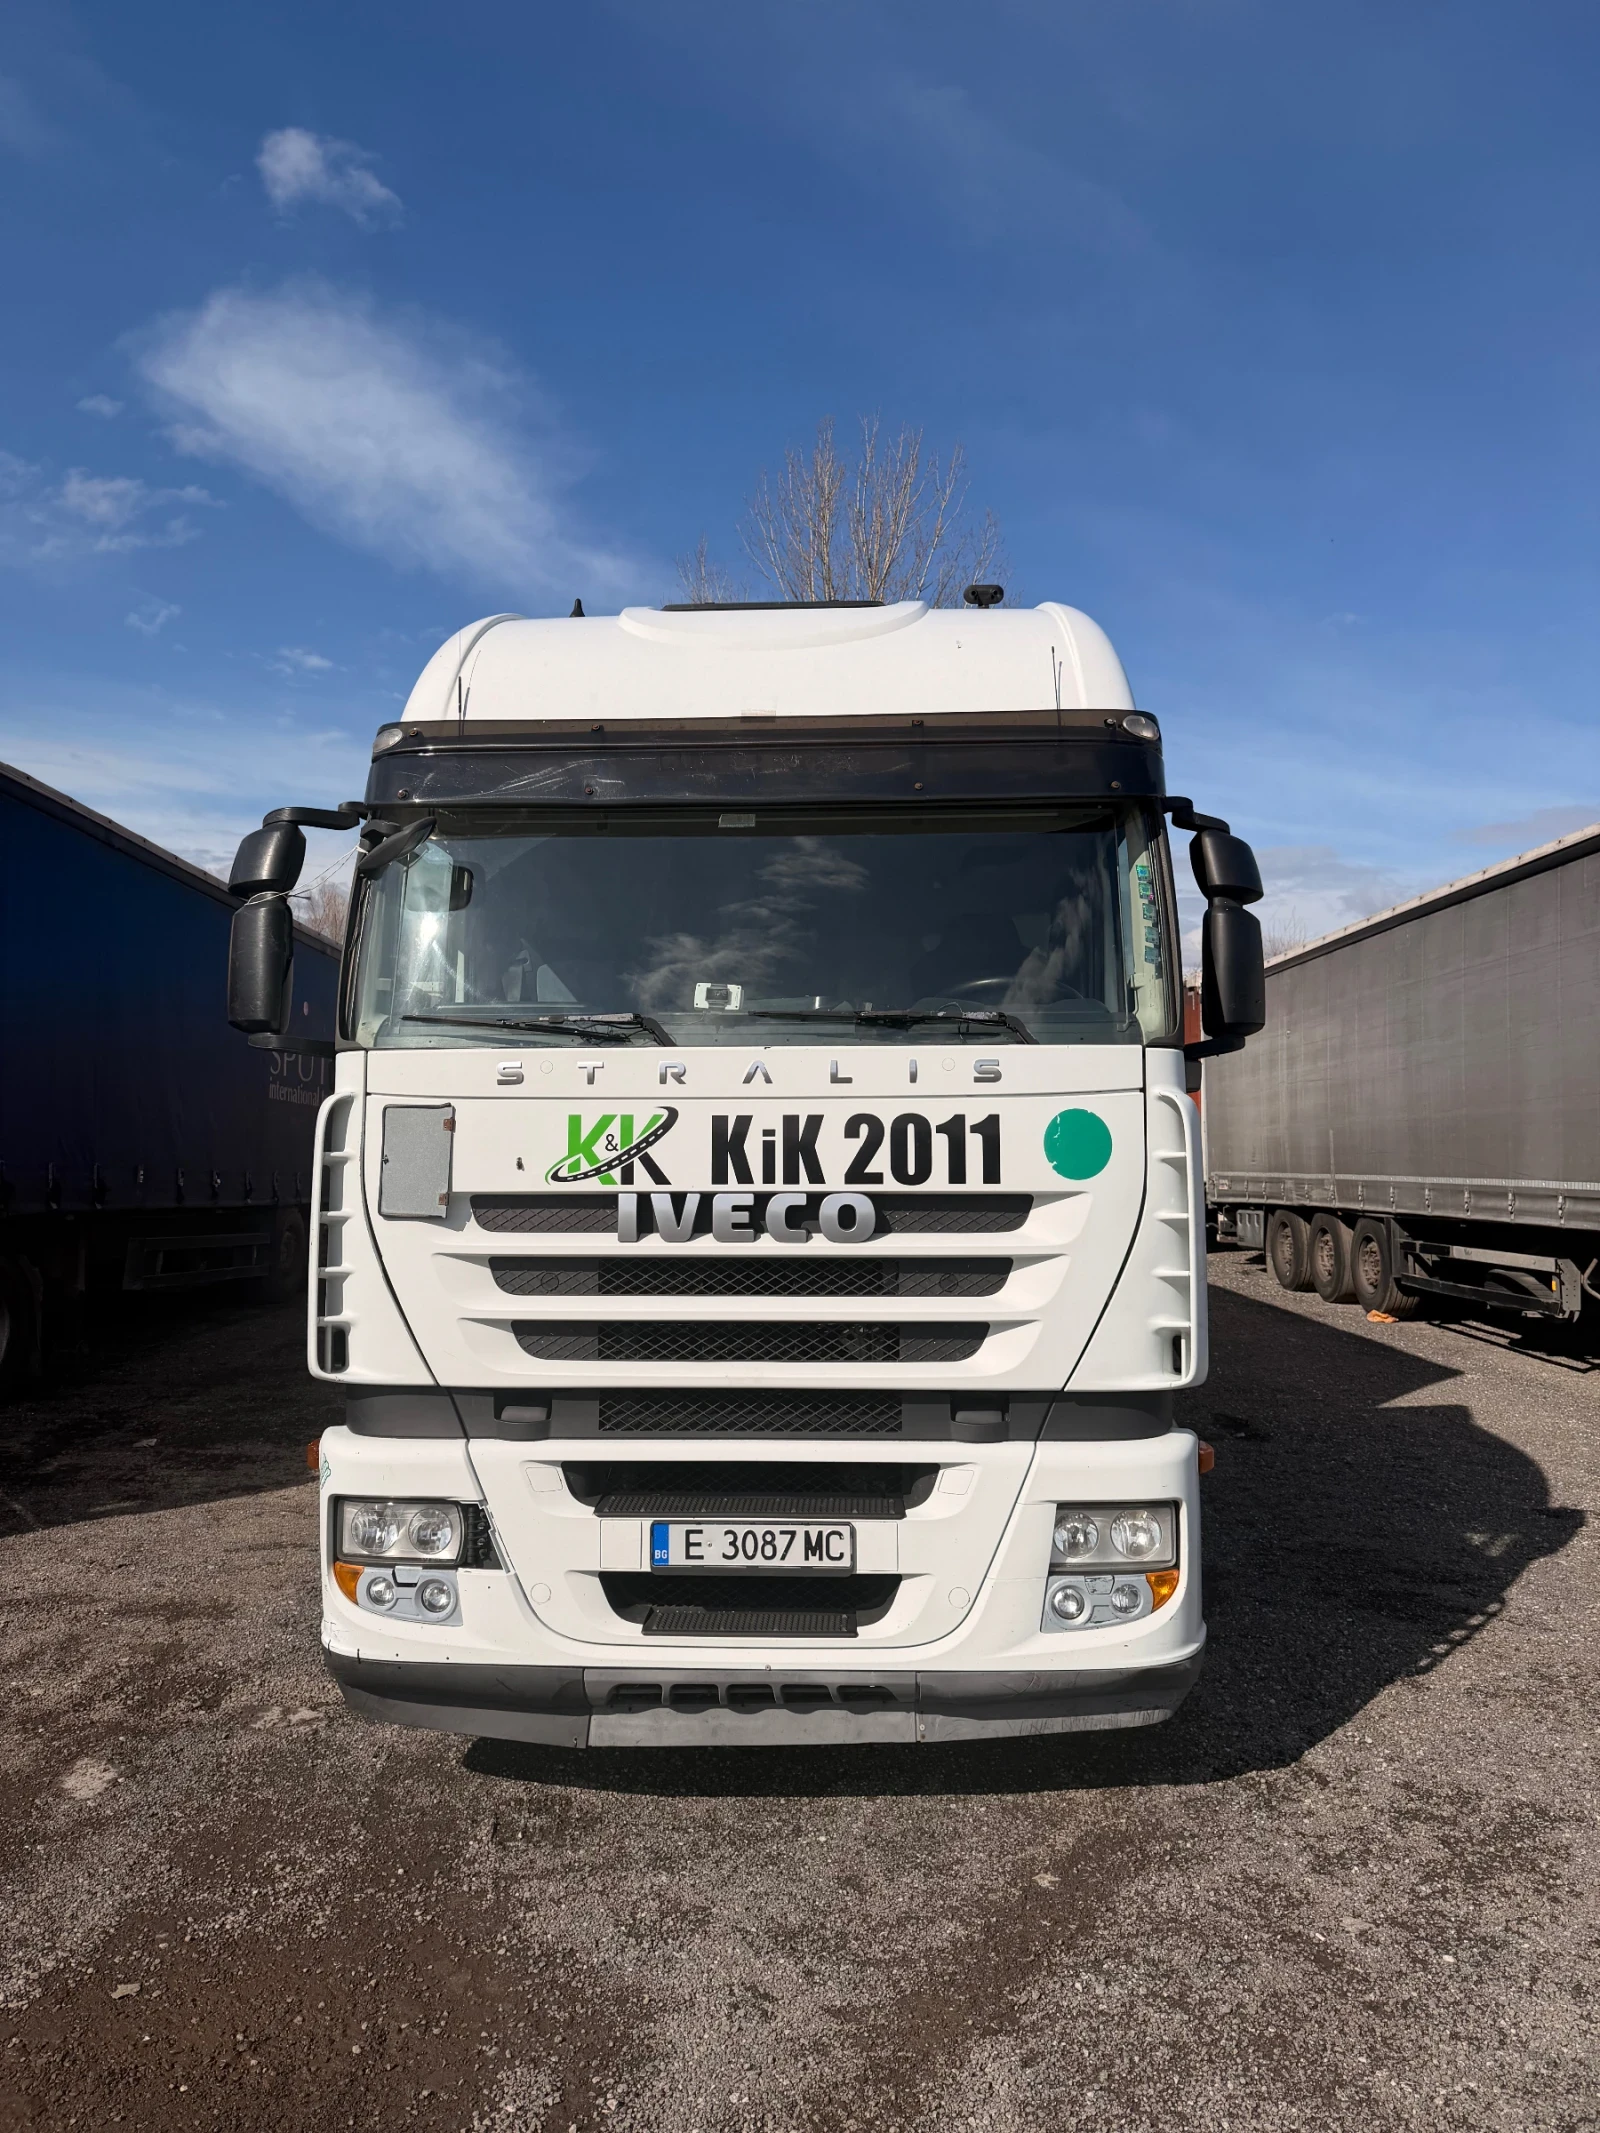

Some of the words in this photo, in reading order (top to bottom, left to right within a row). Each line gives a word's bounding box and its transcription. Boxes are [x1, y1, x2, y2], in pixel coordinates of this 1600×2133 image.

[497, 1060, 1002, 1084] STRALIS
[269, 1077, 320, 1106] international
[711, 1114, 827, 1185] KiK
[843, 1112, 1001, 1186] 2011
[618, 1193, 876, 1243] IVECO
[655, 1549, 668, 1559] BG
[685, 1528, 705, 1560] E
[722, 1529, 797, 1561] 3087
[804, 1529, 845, 1562] MC
